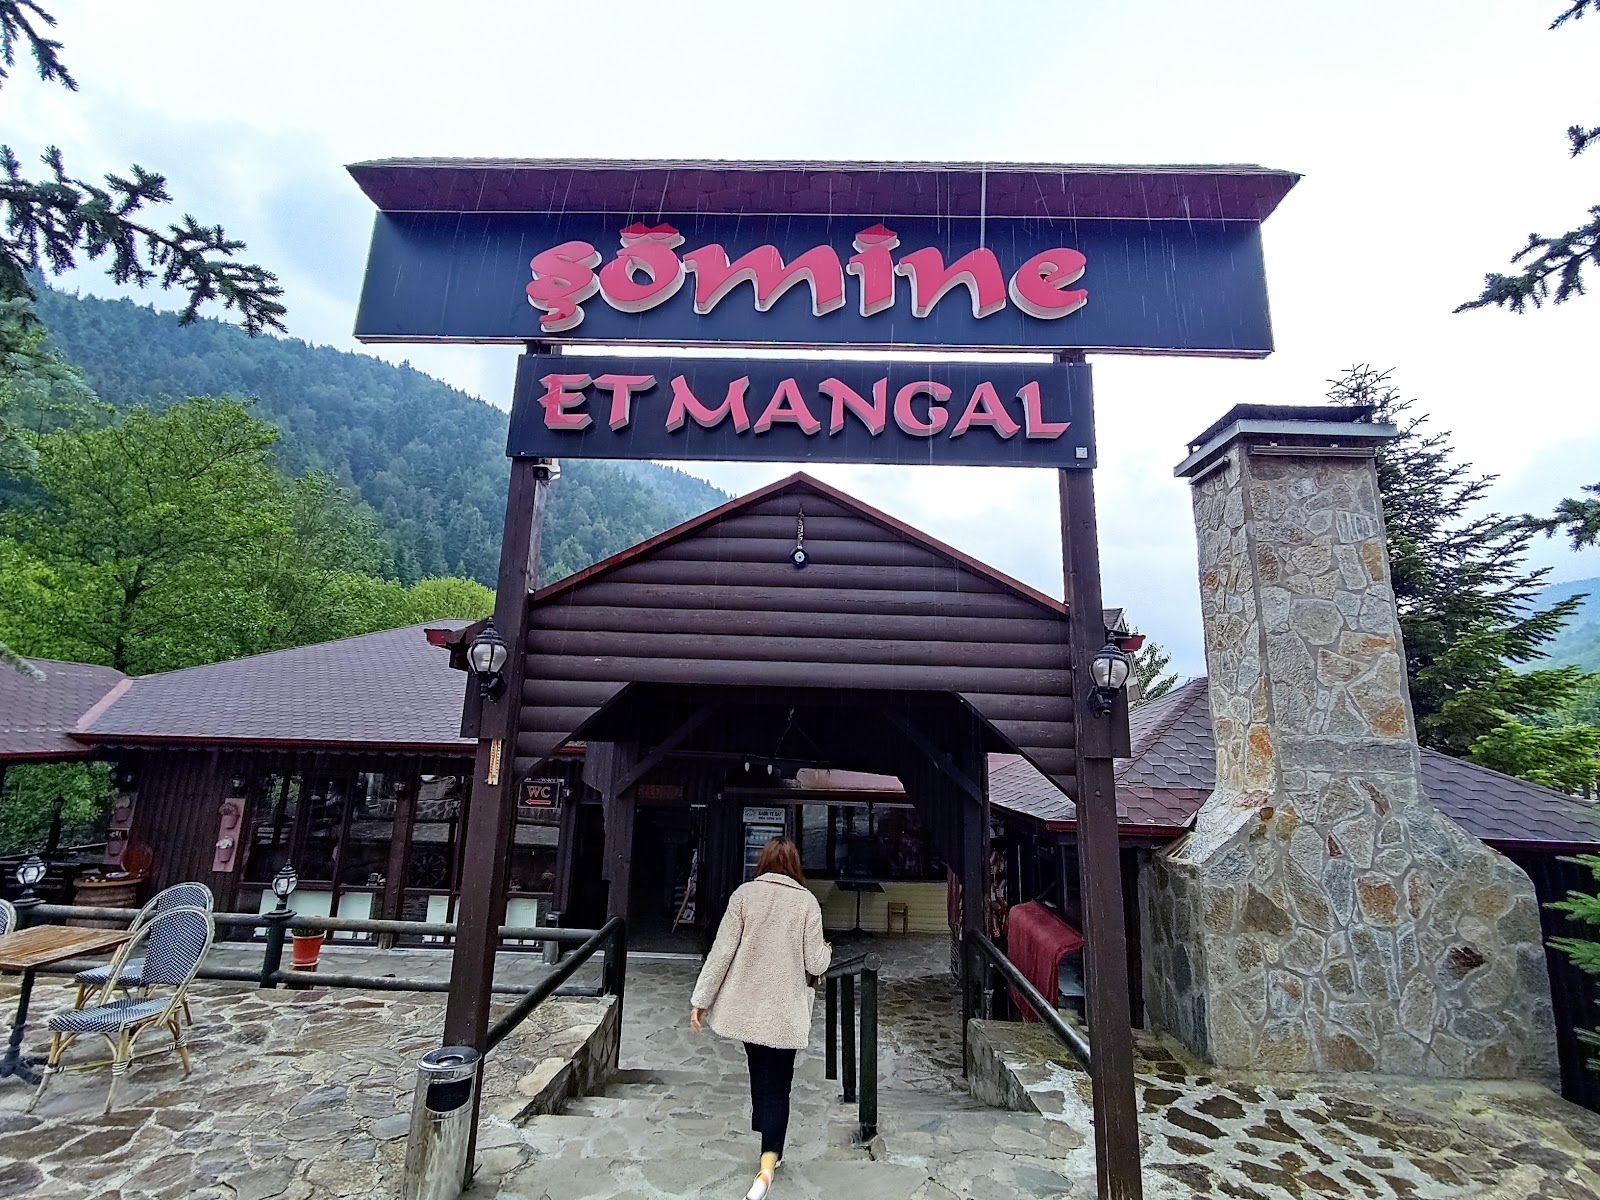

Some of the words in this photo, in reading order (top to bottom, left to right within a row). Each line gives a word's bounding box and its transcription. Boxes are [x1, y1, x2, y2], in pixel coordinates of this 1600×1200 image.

[526, 222, 1089, 332] şömine
[537, 373, 656, 431] ET
[665, 374, 1071, 440] MANGAL
[527, 785, 551, 798] WC
